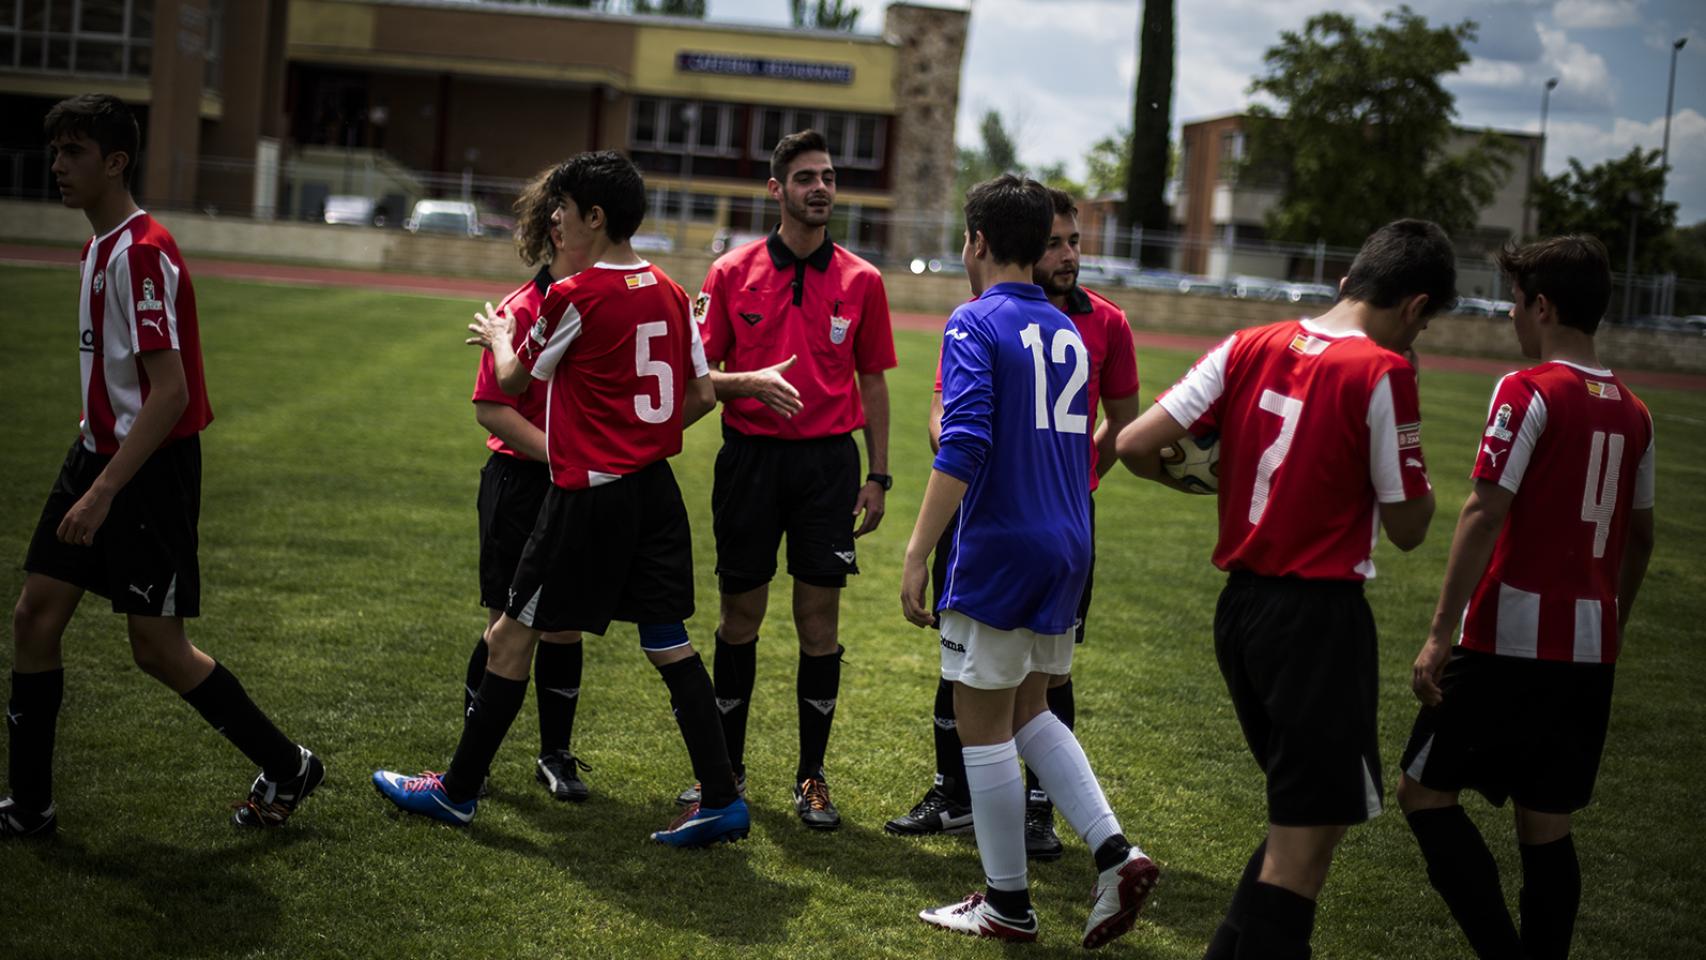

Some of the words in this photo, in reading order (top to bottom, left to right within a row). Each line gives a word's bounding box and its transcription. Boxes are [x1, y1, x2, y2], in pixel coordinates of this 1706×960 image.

[634, 320, 674, 424] 5
[1019, 323, 1089, 435] 12
[1248, 389, 1304, 526] 7
[1581, 431, 1625, 558] 4
